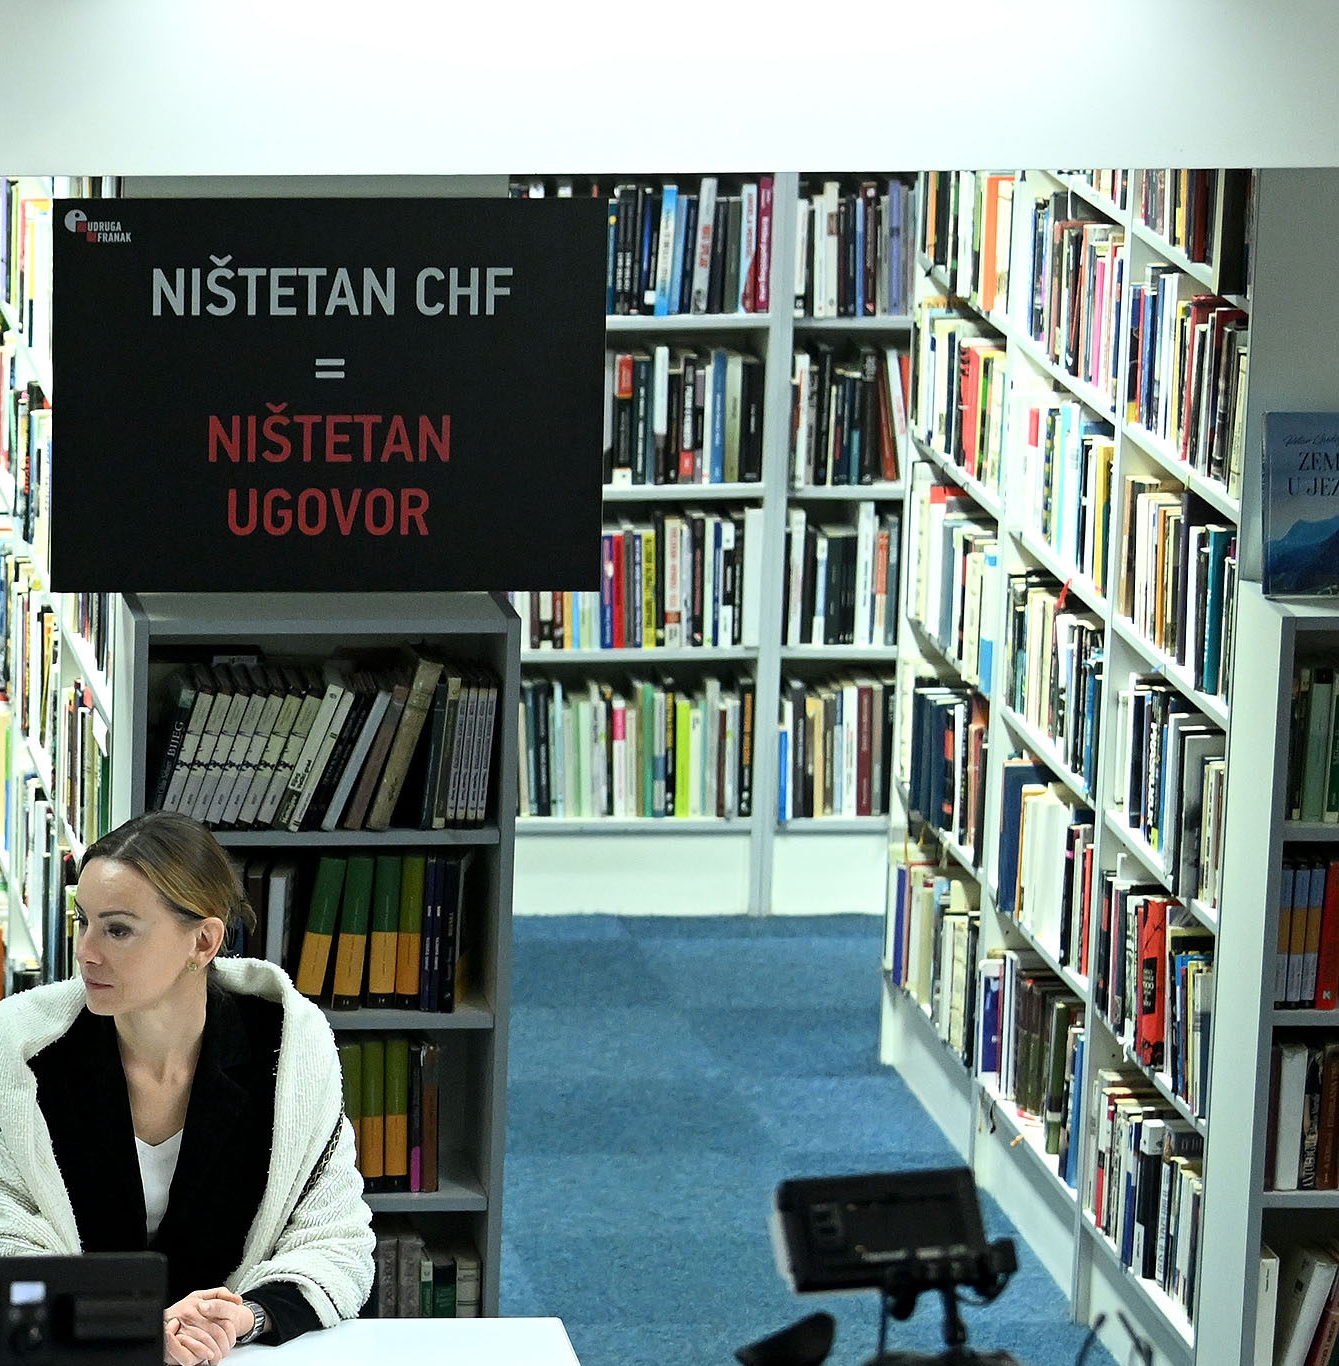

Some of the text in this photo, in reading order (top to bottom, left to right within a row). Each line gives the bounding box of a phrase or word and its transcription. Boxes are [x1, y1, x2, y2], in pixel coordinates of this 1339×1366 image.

[87, 221, 122, 232] UDRUGA
[97, 232, 132, 243] FRANAK
[152, 254, 514, 317] NIŠTETAN CHF
[208, 402, 451, 464] NIŠTETAN
[227, 487, 430, 536] UGOVOR
